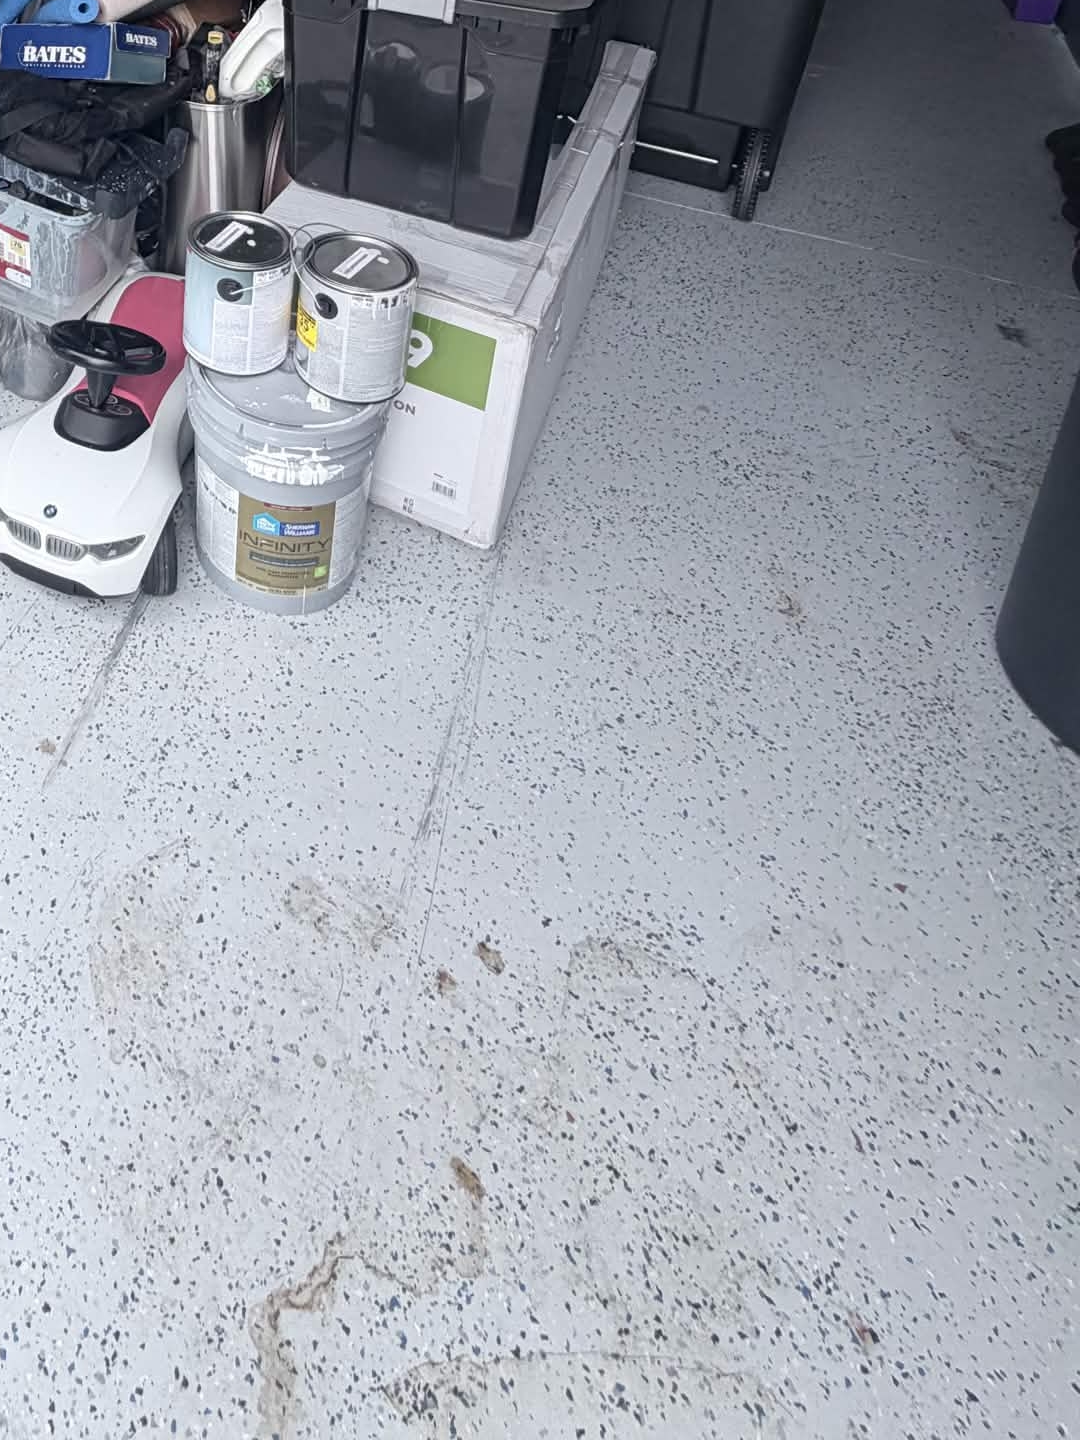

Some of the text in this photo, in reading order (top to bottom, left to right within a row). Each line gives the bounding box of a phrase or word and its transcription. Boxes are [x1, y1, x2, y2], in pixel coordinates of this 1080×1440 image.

[126, 33, 158, 47] BATES
[23, 45, 86, 64] BATES
[393, 399, 416, 416] ON
[239, 530, 331, 553] INFINITY
